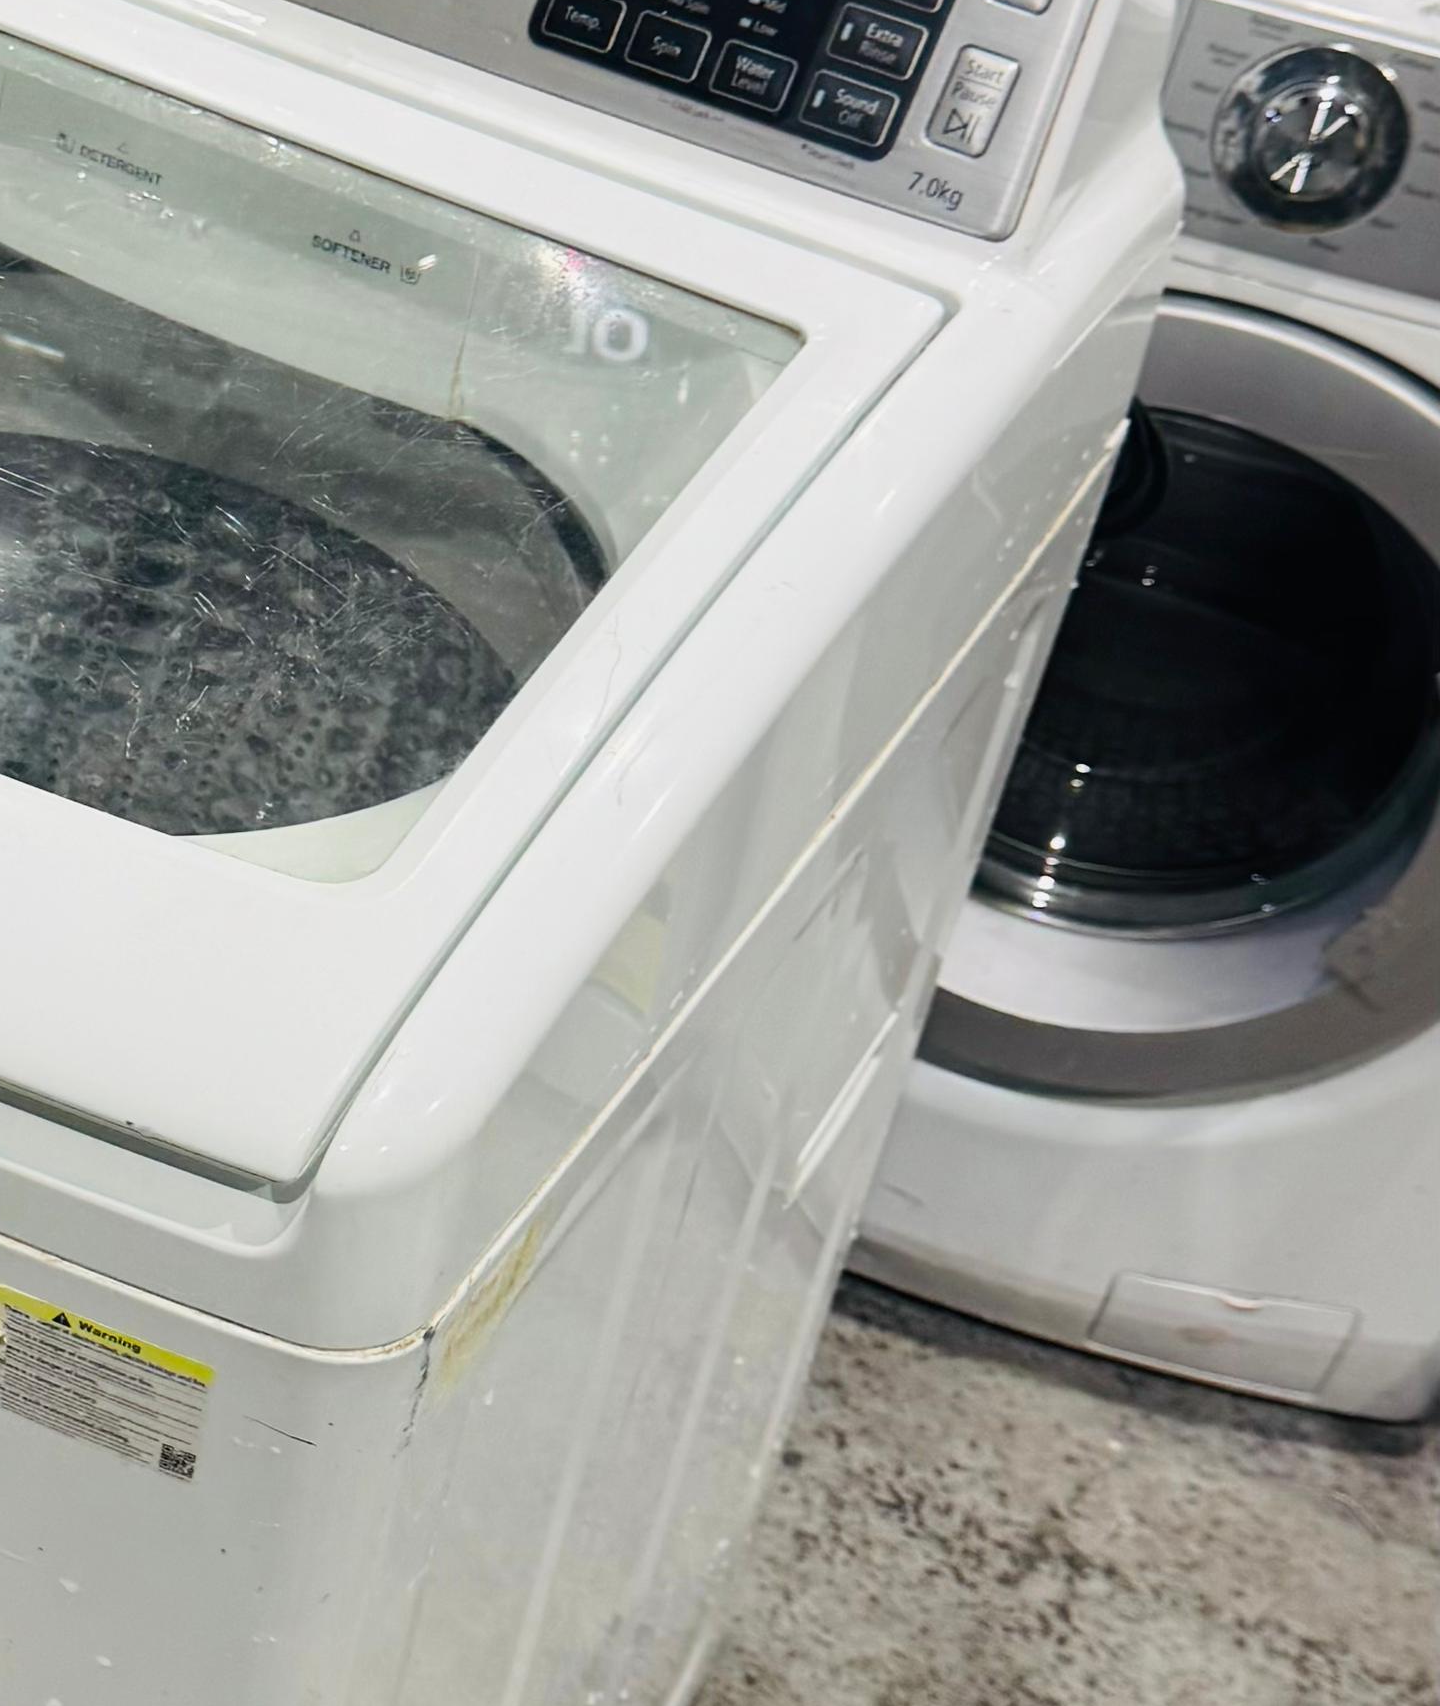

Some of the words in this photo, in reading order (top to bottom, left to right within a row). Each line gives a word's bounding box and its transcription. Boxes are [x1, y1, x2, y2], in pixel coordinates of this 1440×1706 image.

[564, 4, 602, 32] Temp.
[650, 35, 683, 59] Spin
[865, 22, 906, 49] Extra
[730, 68, 769, 94] Level
[734, 54, 777, 81] Water
[963, 58, 1007, 86] Start
[833, 88, 881, 116] Sound
[950, 79, 1000, 109] Pause
[837, 109, 866, 128] Off
[78, 143, 163, 187] DETERGENT
[907, 170, 964, 211] 7.0kg
[311, 234, 392, 275] SOFTENER
[78, 1319, 143, 1355] Warning
